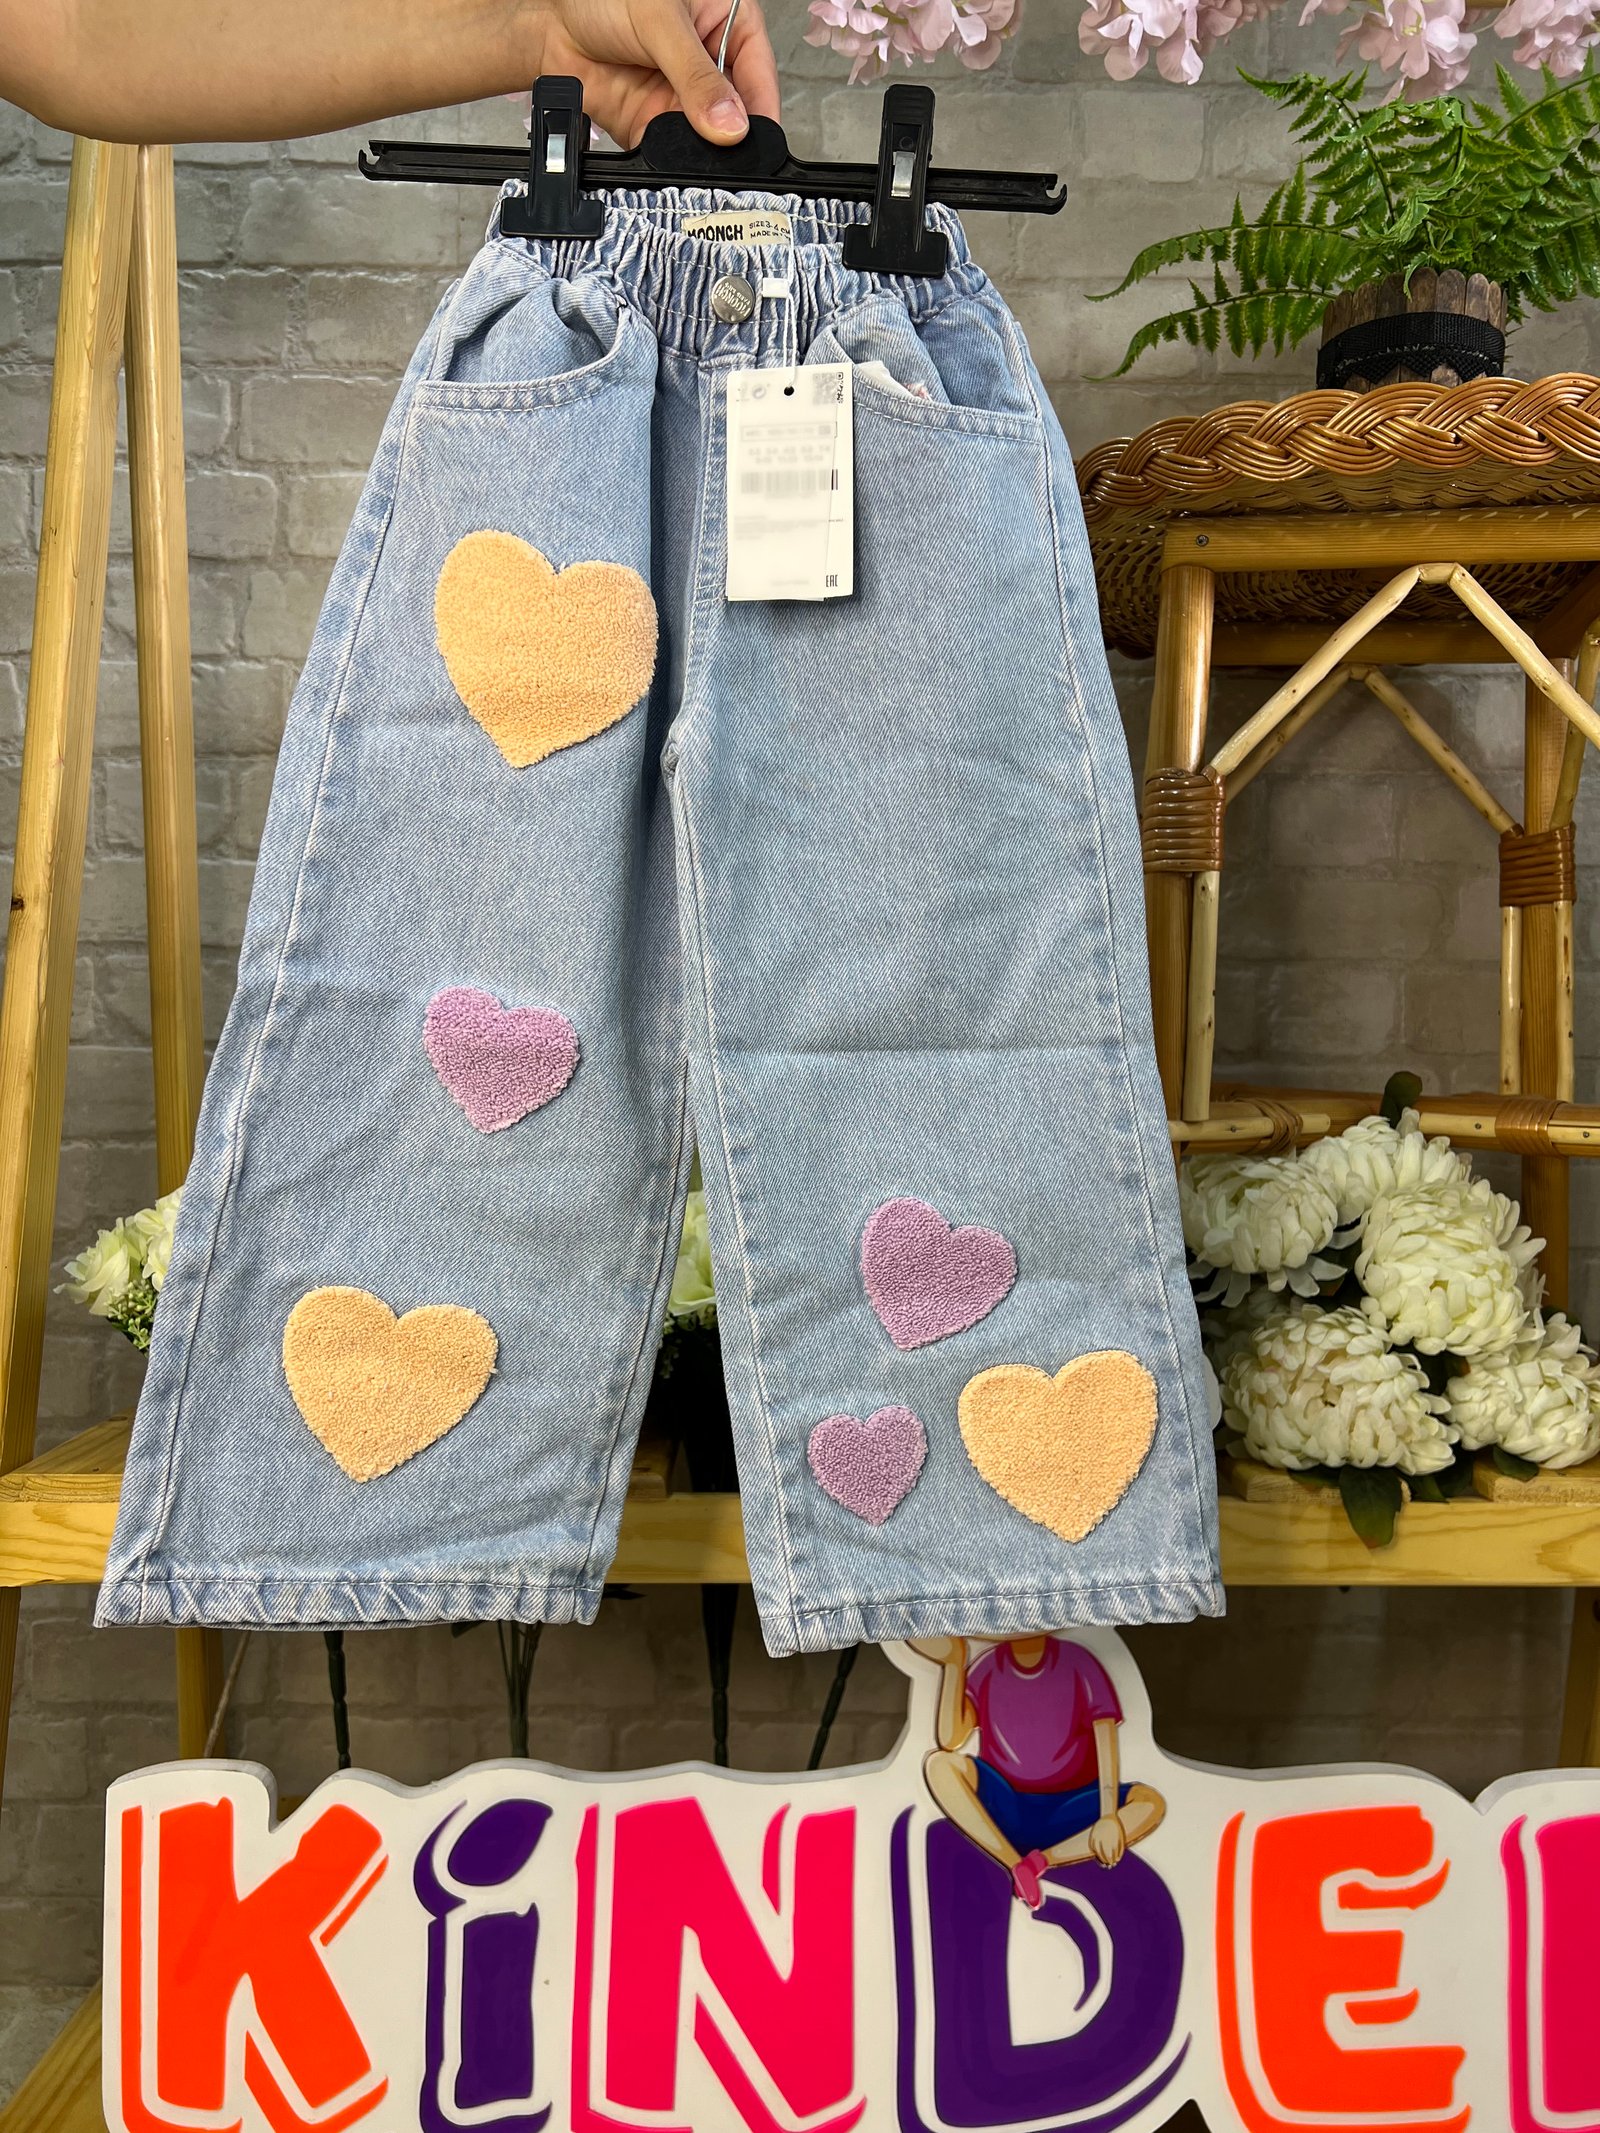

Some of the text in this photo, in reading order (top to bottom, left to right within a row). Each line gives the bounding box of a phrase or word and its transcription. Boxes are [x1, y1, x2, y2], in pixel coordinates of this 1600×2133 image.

[749, 221, 764, 230] SIZE
[750, 230, 771, 239] MADE
[825, 574, 838, 587] EAC
